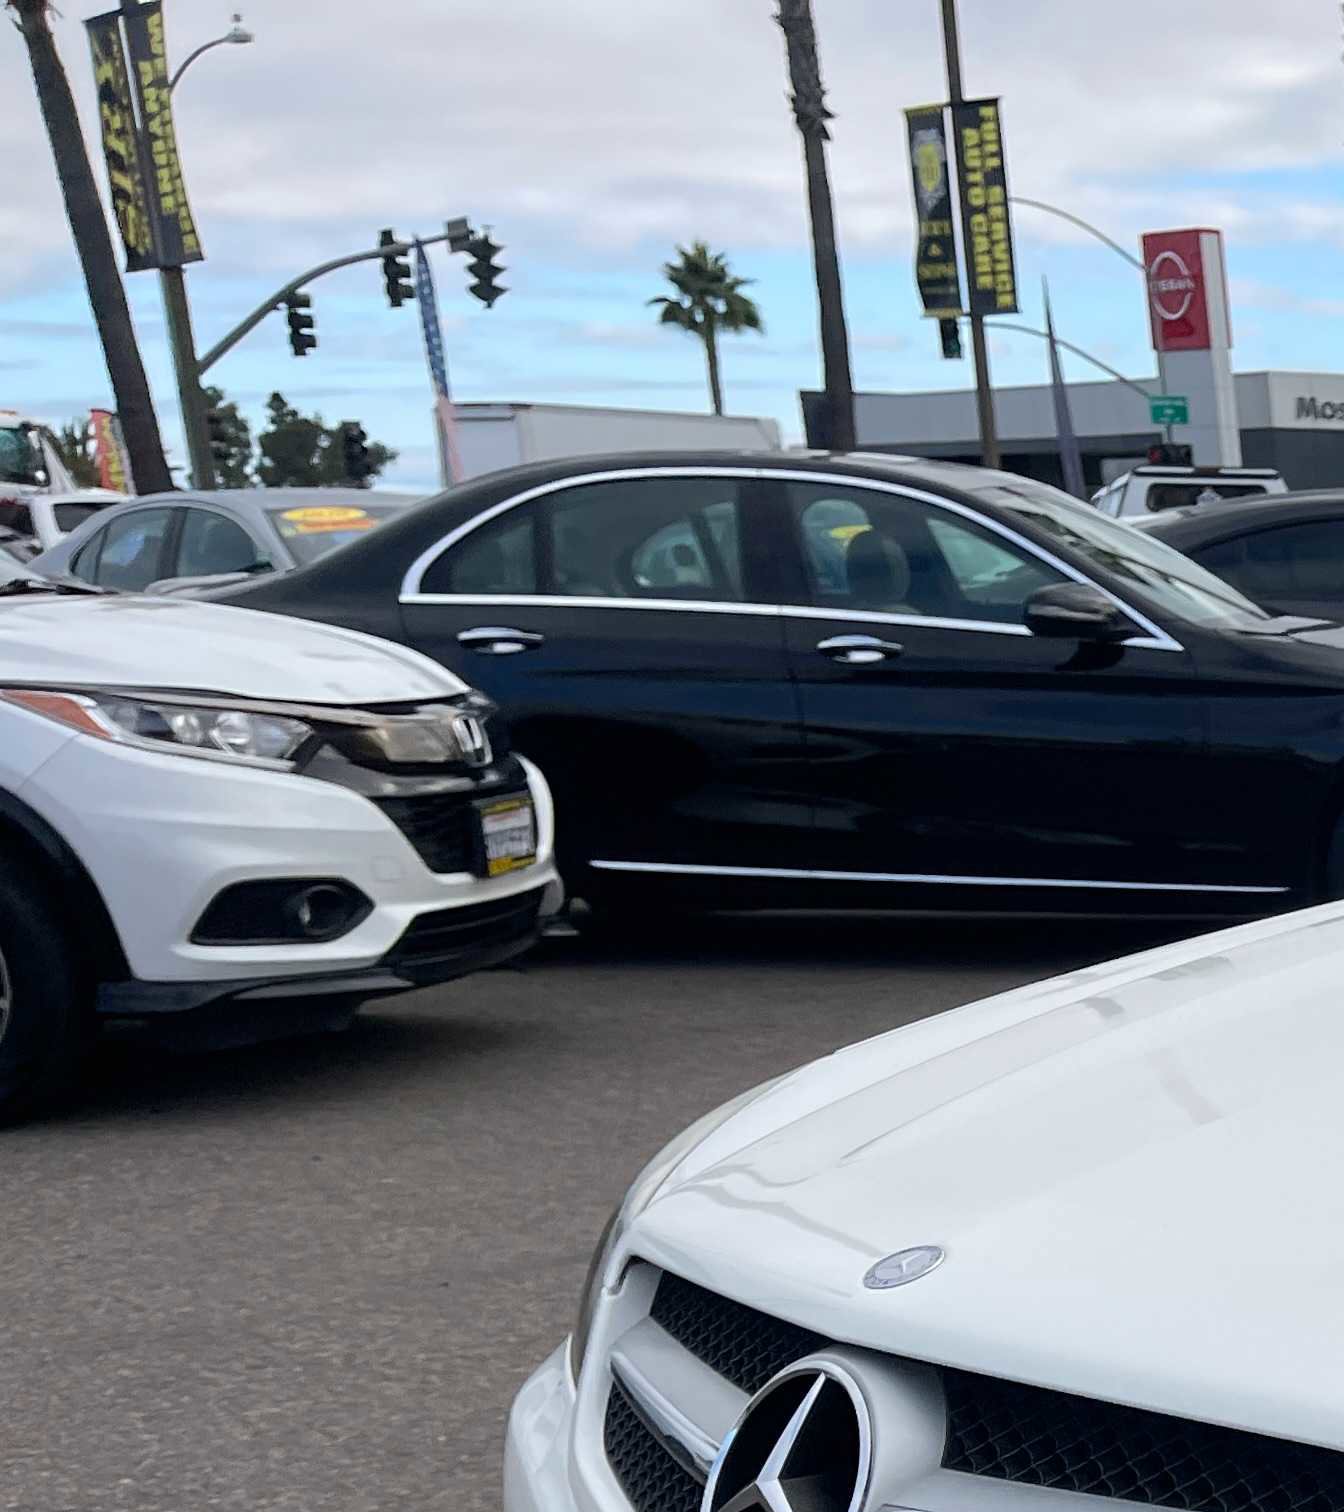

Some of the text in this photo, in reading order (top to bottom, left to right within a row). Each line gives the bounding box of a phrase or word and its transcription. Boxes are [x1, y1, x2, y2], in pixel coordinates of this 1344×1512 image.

[962, 127, 993, 290] AUTO CARE
[978, 105, 1013, 309] FULL SERVICE
